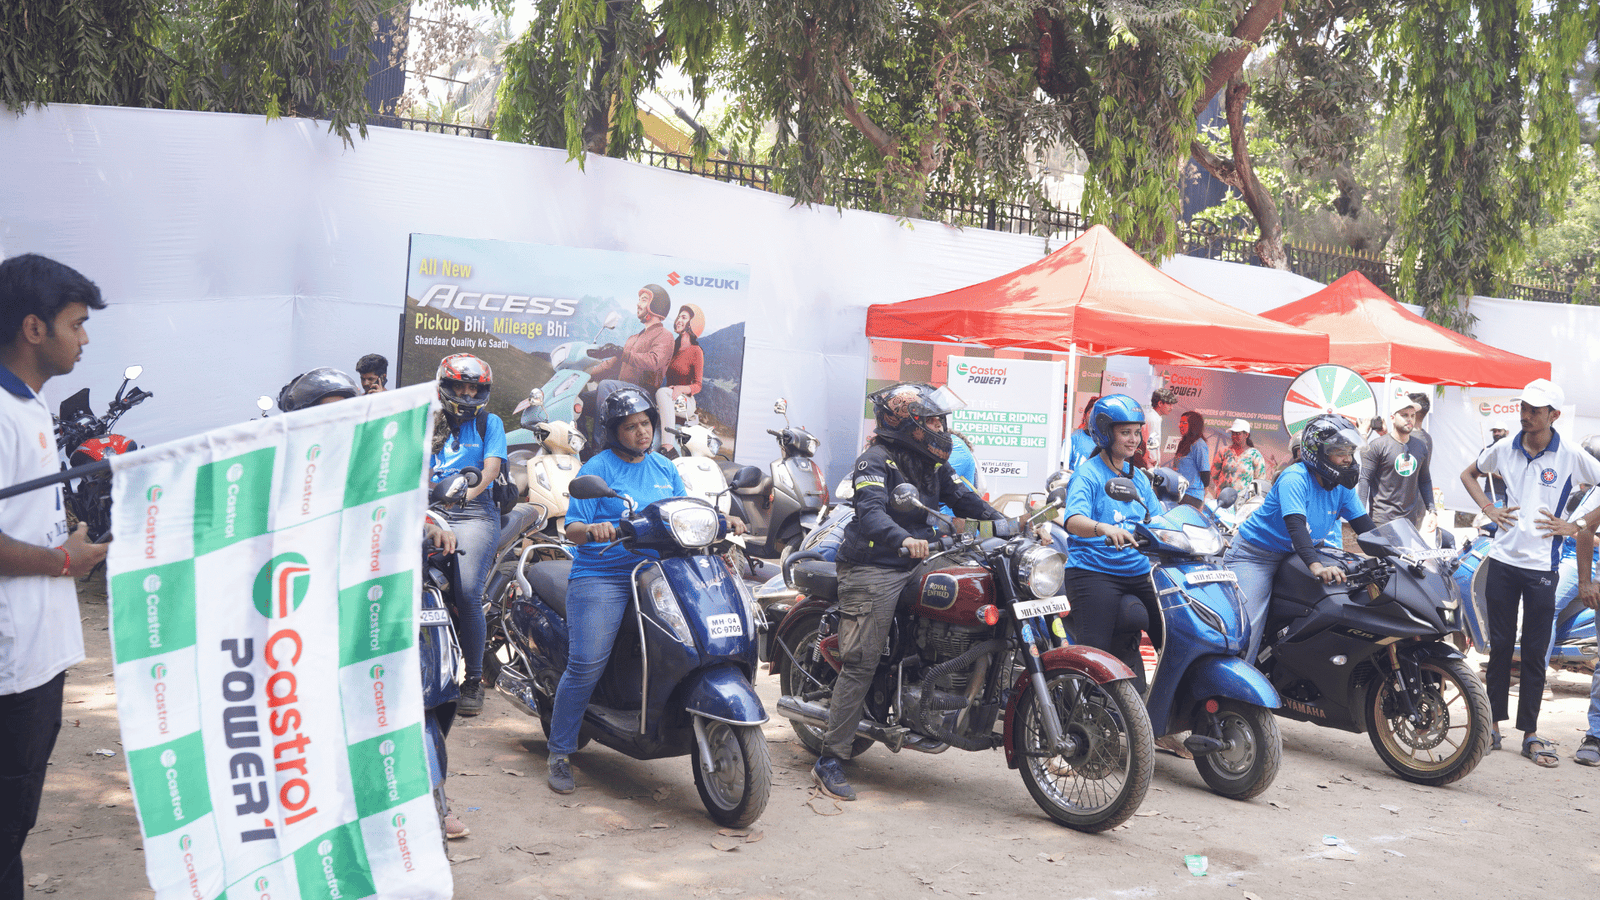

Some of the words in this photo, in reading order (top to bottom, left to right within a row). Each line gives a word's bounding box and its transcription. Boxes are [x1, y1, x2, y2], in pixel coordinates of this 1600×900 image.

[418, 258, 438, 276] All
[441, 260, 472, 278] New
[683, 275, 740, 291] SUZUKI
[415, 313, 460, 334] Pickup
[464, 316, 489, 335] Bhi,
[493, 317, 543, 340] Mileage
[547, 320, 570, 338] Bhi.
[414, 335, 449, 346] Shandaar
[450, 337, 477, 349] Quality
[477, 338, 487, 348] Ke
[488, 340, 509, 349] Saath
[969, 365, 1007, 377] Castrol
[1170, 372, 1203, 386] Castrol
[954, 410, 1007, 421] ULTIMATE
[1008, 413, 1046, 423] RIDING
[1195, 408, 1219, 416] PIONEERS
[1226, 410, 1258, 419] TECHNOLOGY
[1257, 413, 1282, 421] POWERING
[1493, 403, 1520, 414] Cast
[953, 422, 1021, 434] EXPERIENCE
[967, 435, 985, 445] OM
[987, 436, 1018, 446] YOUR
[1020, 437, 1045, 447] BIKE
[376, 441, 395, 494] Castrol
[1000, 467, 1021, 475] SPEC
[302, 463, 318, 516] Castrol
[225, 483, 240, 539] Castrol
[145, 504, 160, 560] Castrol
[370, 523, 384, 573] Castrol
[926, 589, 950, 599] ENFIELD
[929, 582, 947, 591] ROYAL
[146, 594, 163, 648] Castrol
[369, 602, 381, 651] Castrol
[153, 682, 170, 735] Castrol
[373, 680, 389, 728] Castrol
[1286, 699, 1327, 719] YAMAHA
[264, 628, 318, 826] Castrol
[383, 756, 401, 802] Castrol
[165, 767, 185, 821] Castrol
[395, 828, 417, 873] Castrol
